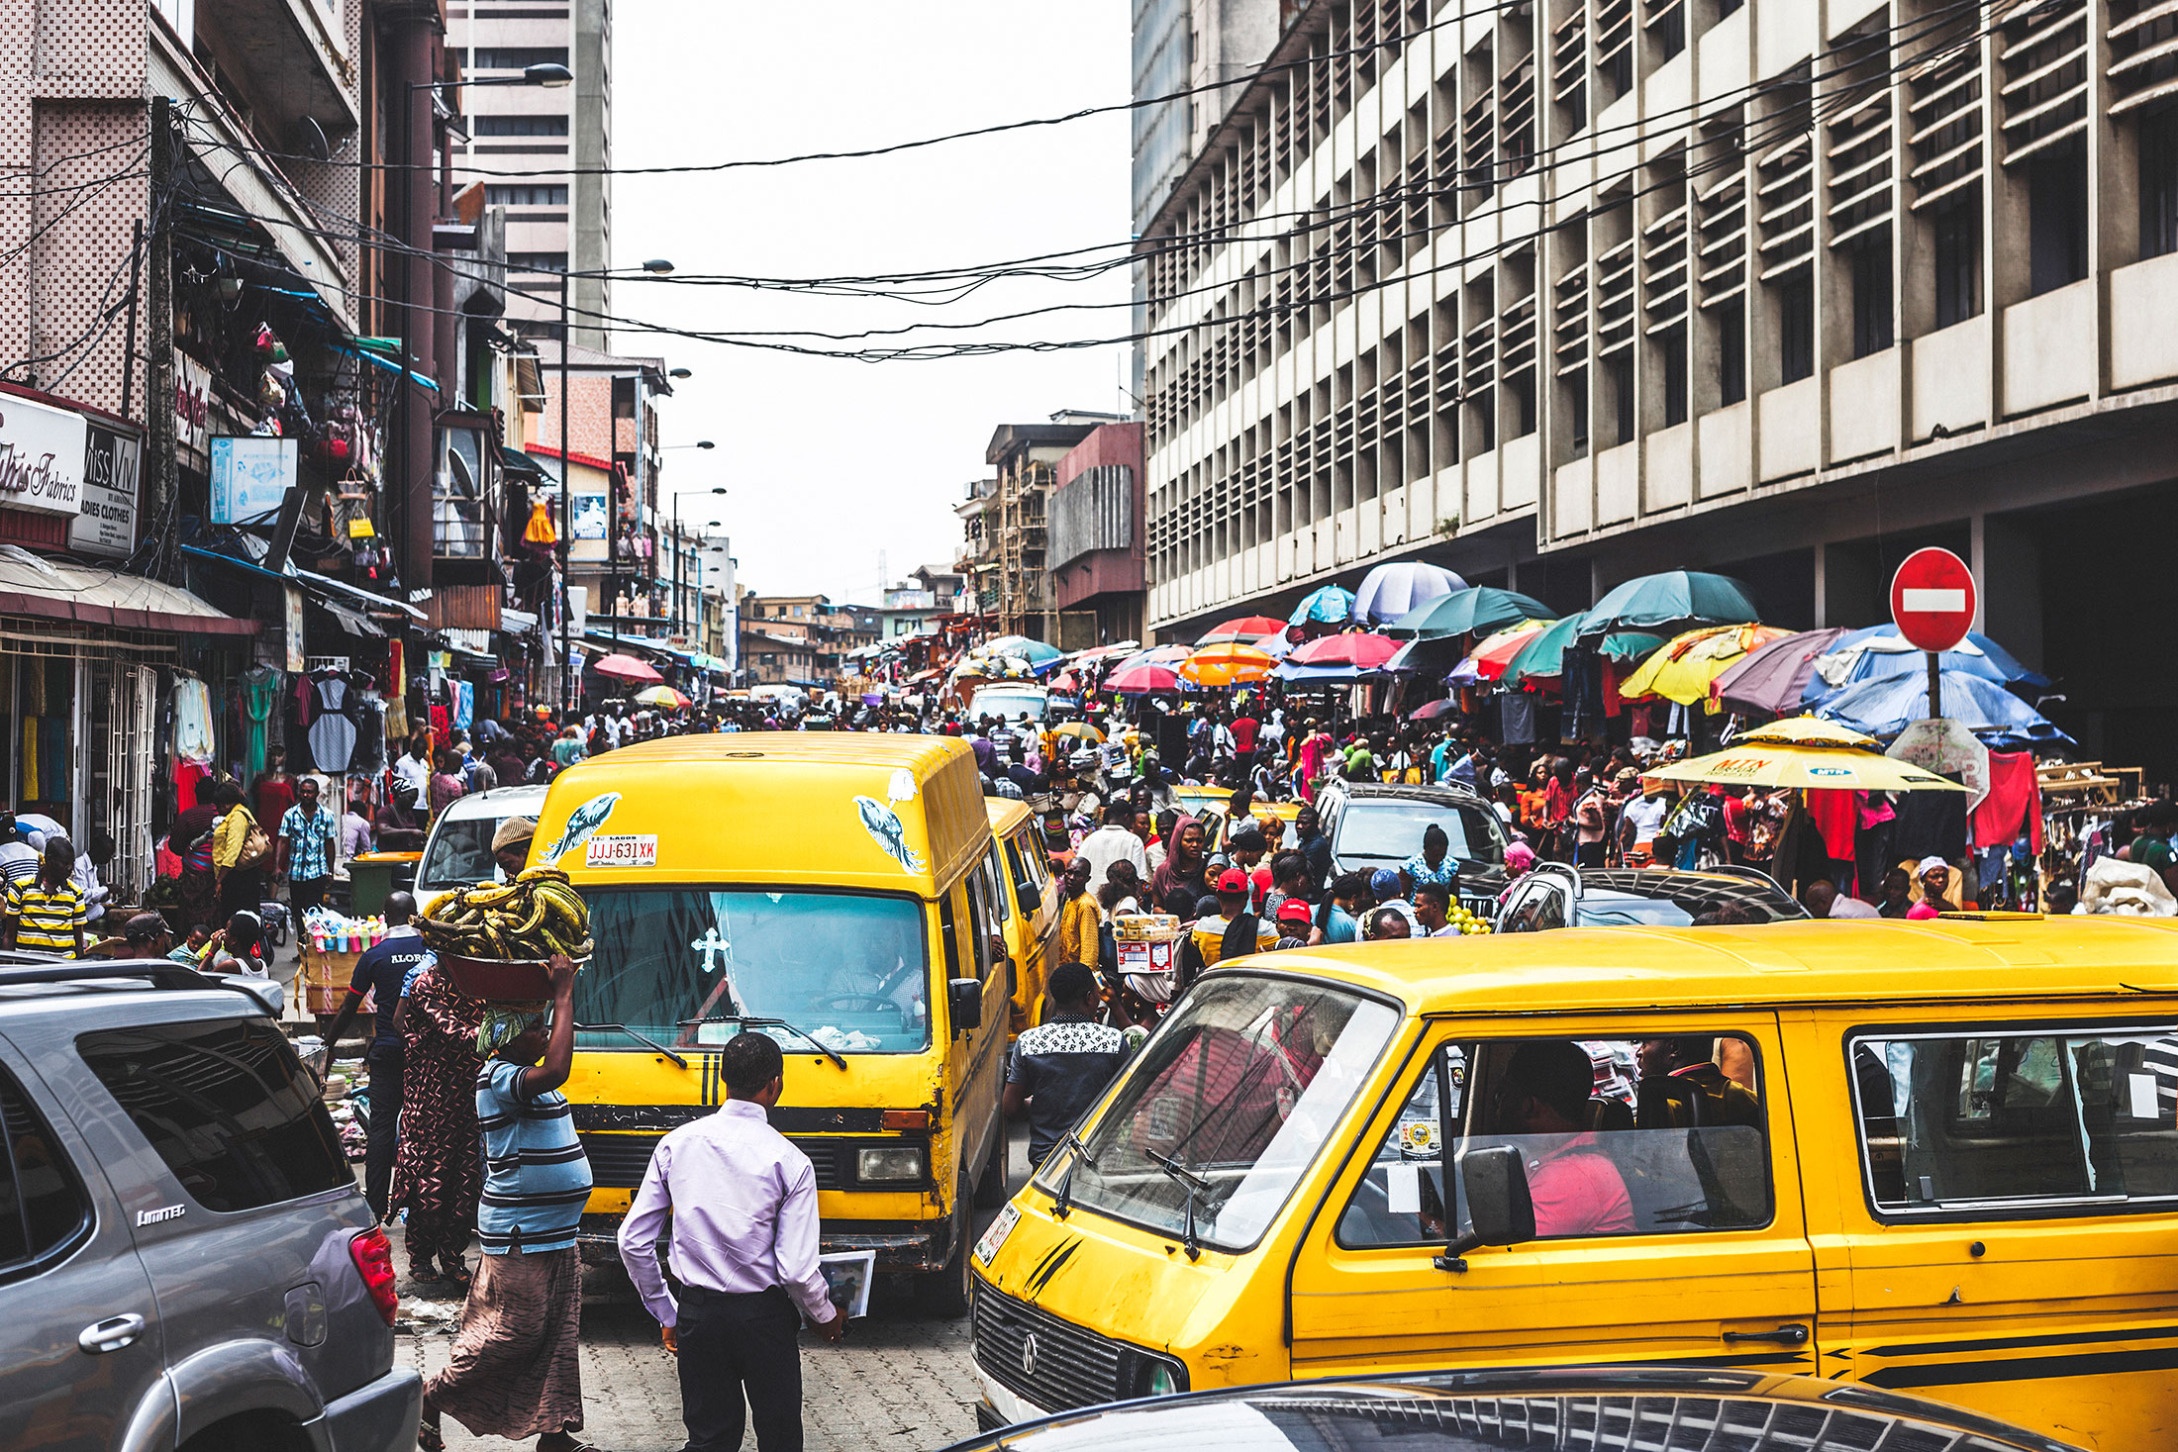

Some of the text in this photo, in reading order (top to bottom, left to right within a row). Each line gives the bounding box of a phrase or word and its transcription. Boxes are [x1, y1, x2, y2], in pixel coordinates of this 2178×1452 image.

[30, 453, 76, 502] Fabrics
[80, 499, 100, 518] ADIES
[101, 504, 130, 524] CLOTHES
[1714, 759, 1772, 769] MTN
[137, 1204, 185, 1226] LIMITED
